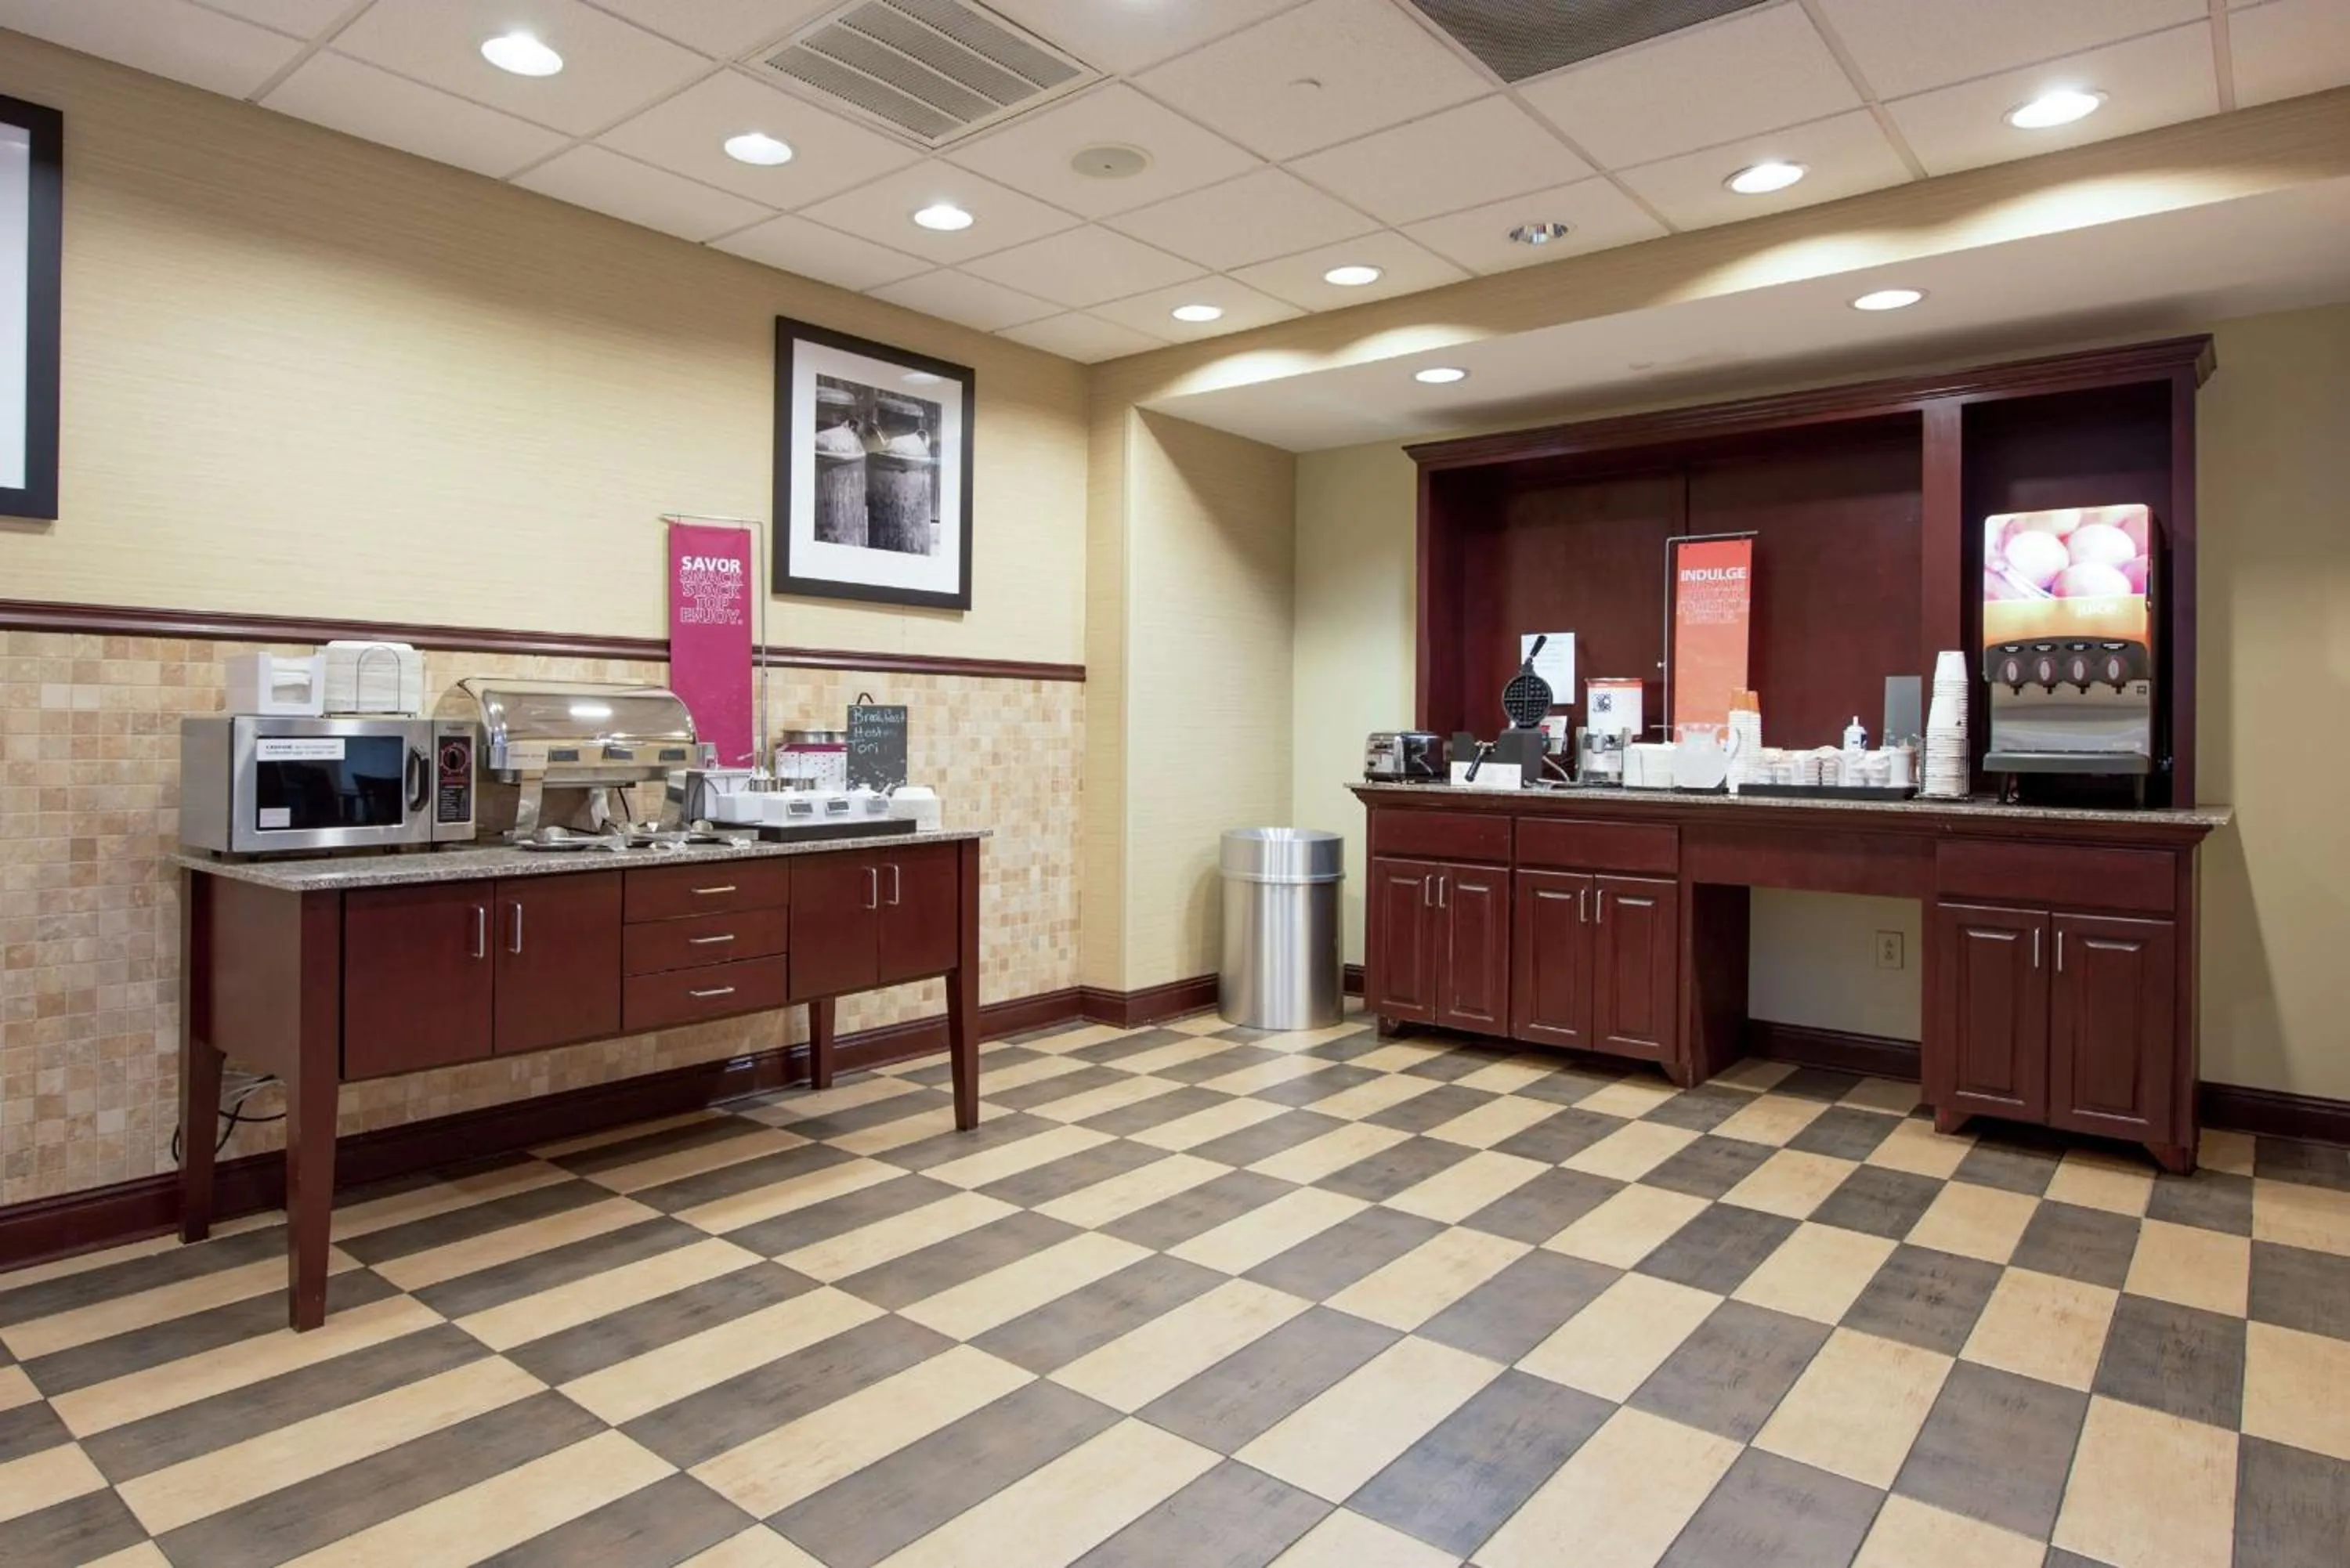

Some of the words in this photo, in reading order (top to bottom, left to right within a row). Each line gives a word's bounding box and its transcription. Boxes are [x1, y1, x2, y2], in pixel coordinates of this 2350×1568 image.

[682, 555, 741, 573] SAVOR
[679, 569, 743, 586] SNACK
[1680, 567, 1747, 582] INDULGE
[693, 595, 729, 611] TOP
[847, 739, 879, 756] Tori
